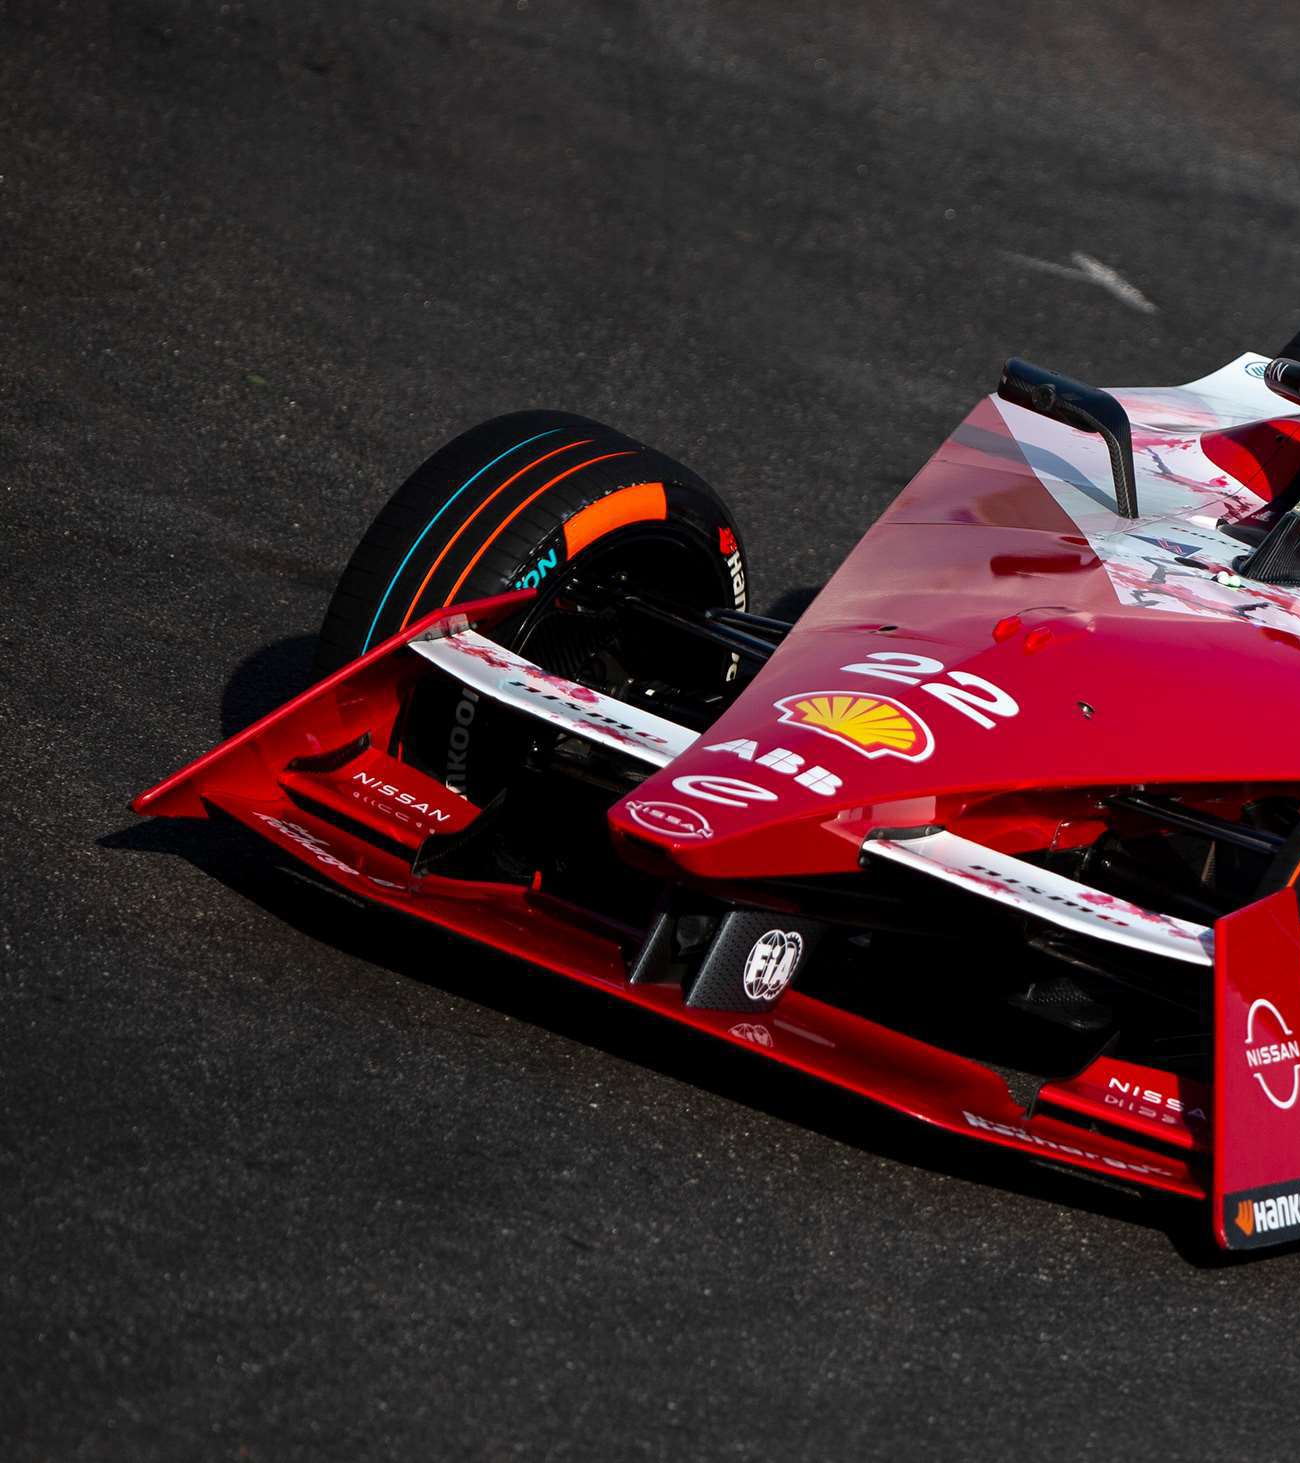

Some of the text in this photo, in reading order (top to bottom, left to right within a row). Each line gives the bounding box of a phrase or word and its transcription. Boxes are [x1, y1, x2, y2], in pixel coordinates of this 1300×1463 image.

[839, 651, 1020, 730] 22
[703, 738, 843, 797] ABB
[352, 771, 450, 822] NISSAN
[626, 799, 714, 839] NISSAN
[1246, 1040, 1300, 1068] NISSAN
[1109, 1076, 1207, 1121] NISSA
